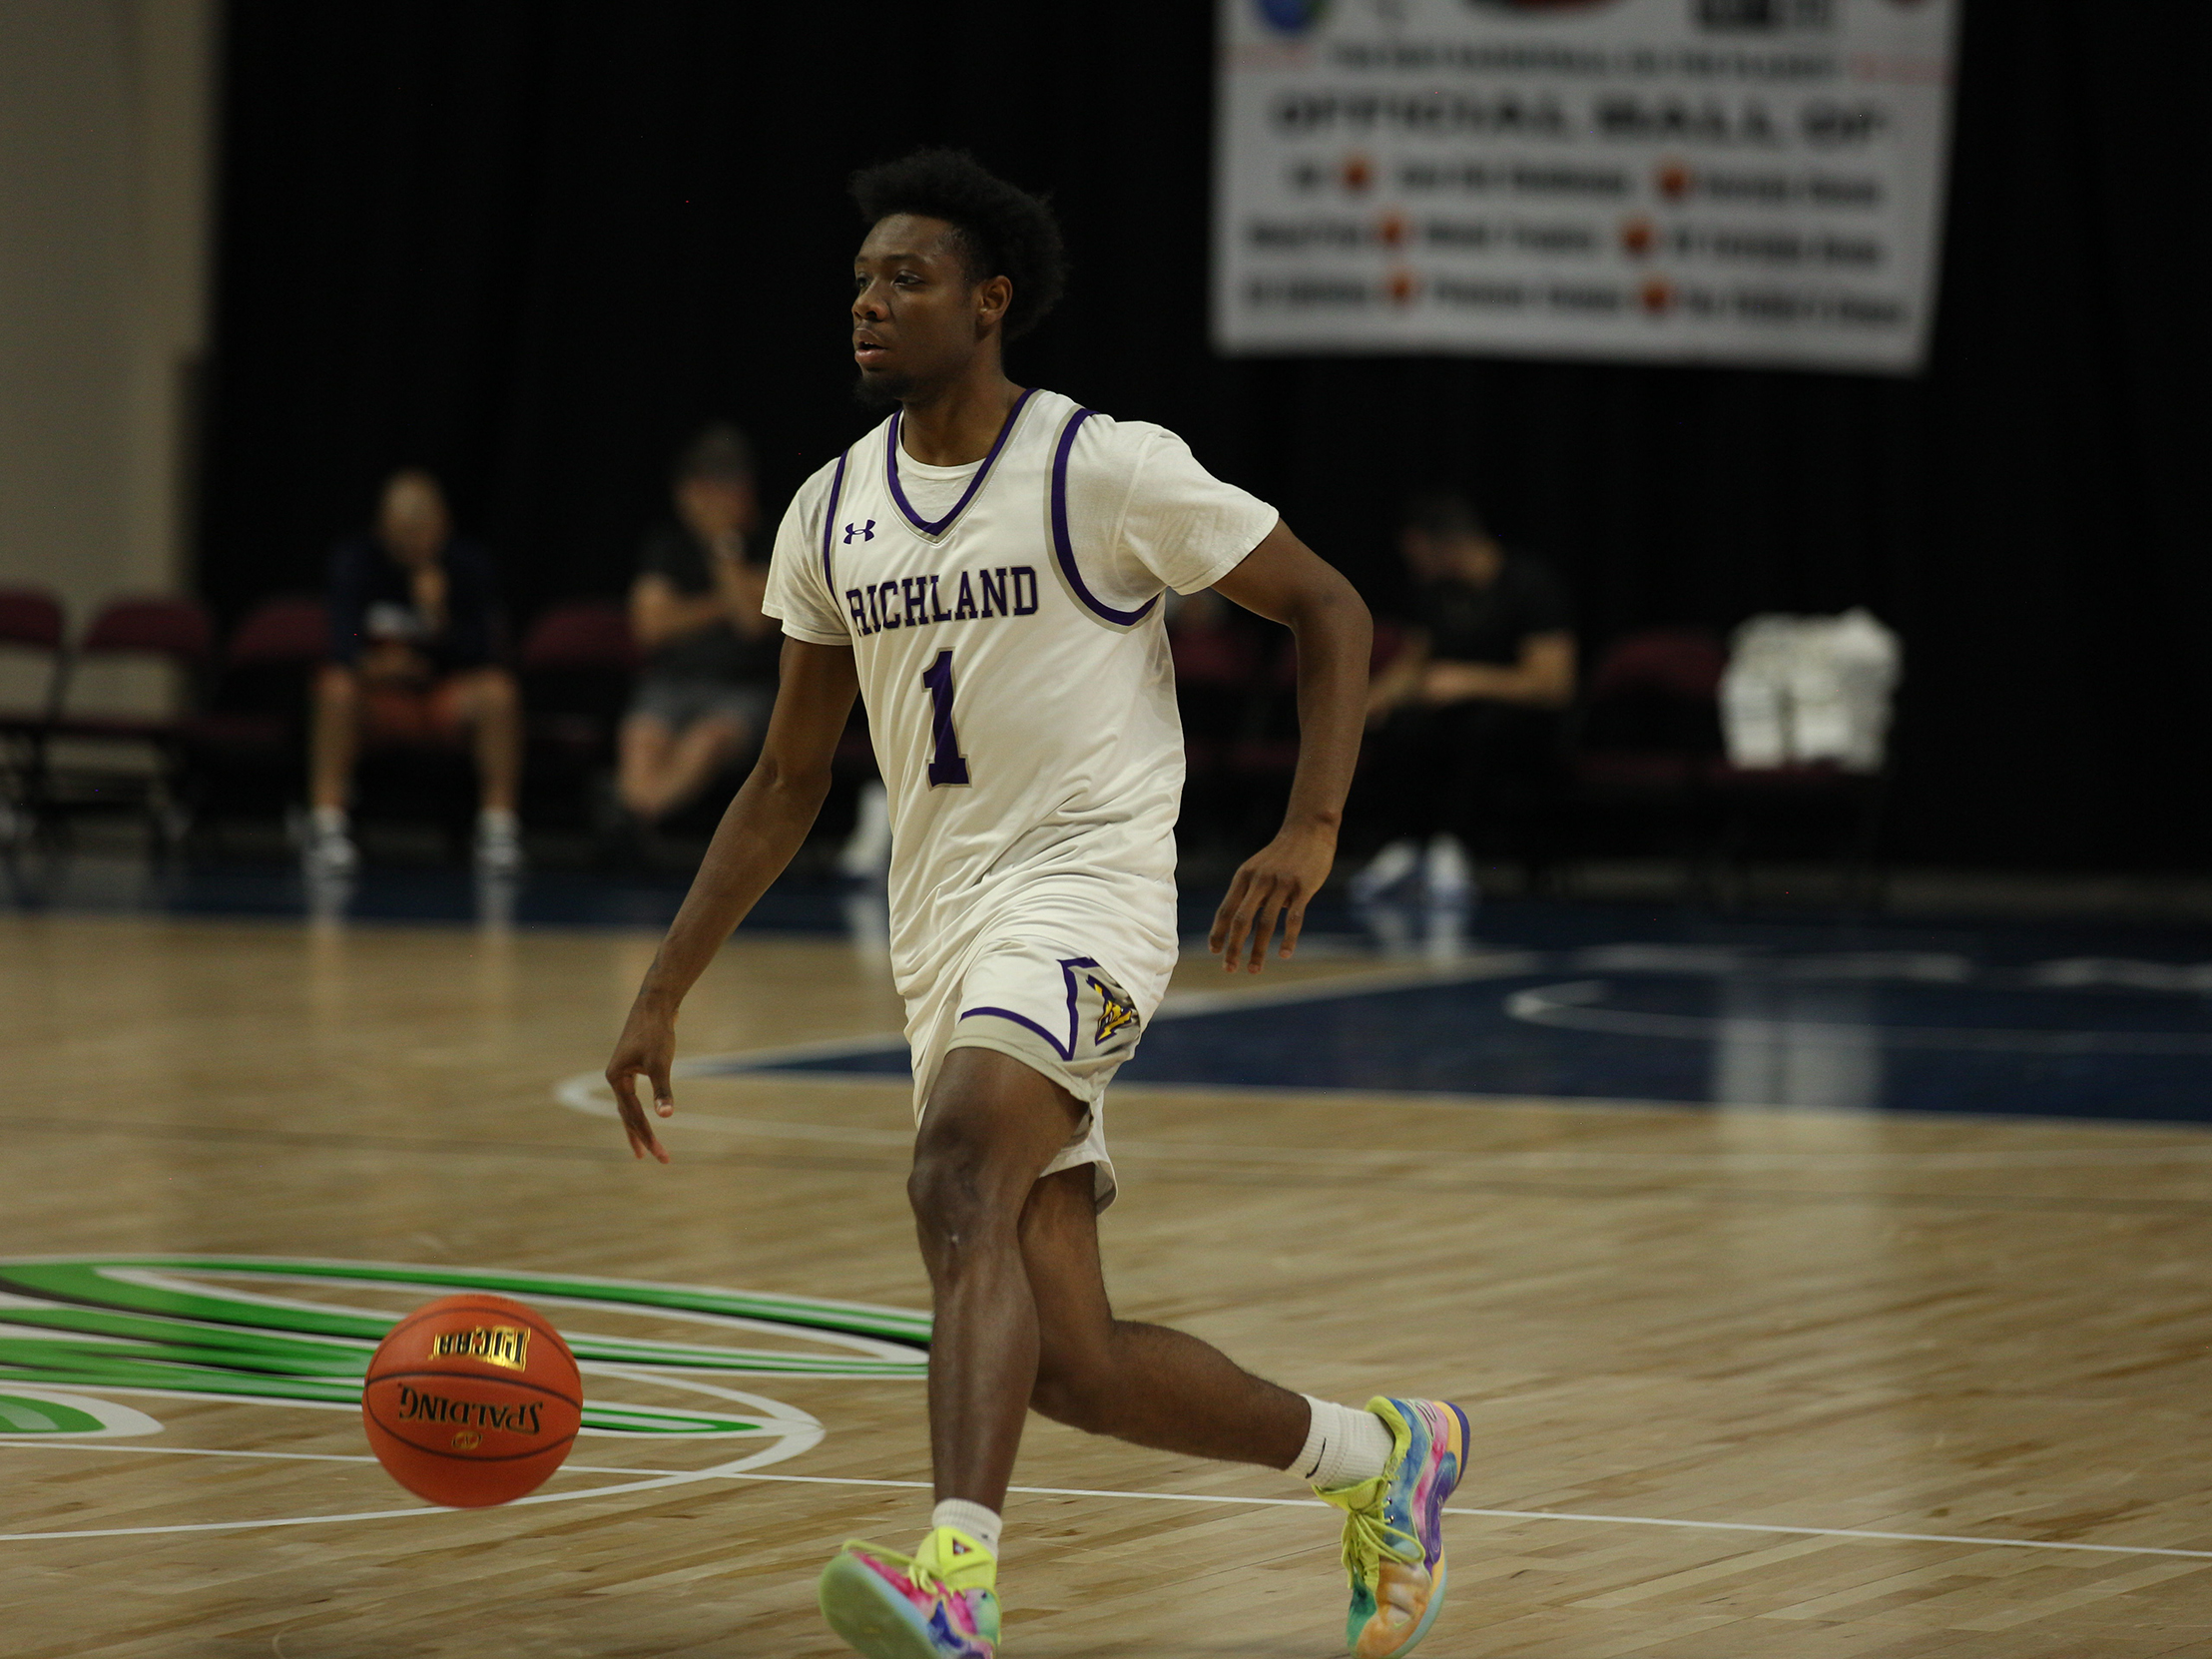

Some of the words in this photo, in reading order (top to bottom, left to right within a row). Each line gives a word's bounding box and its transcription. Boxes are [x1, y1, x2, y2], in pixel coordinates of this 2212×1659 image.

[844, 565, 1039, 638] RICHLAND
[920, 646, 972, 791] 1
[399, 1384, 543, 1435] SPALDING
